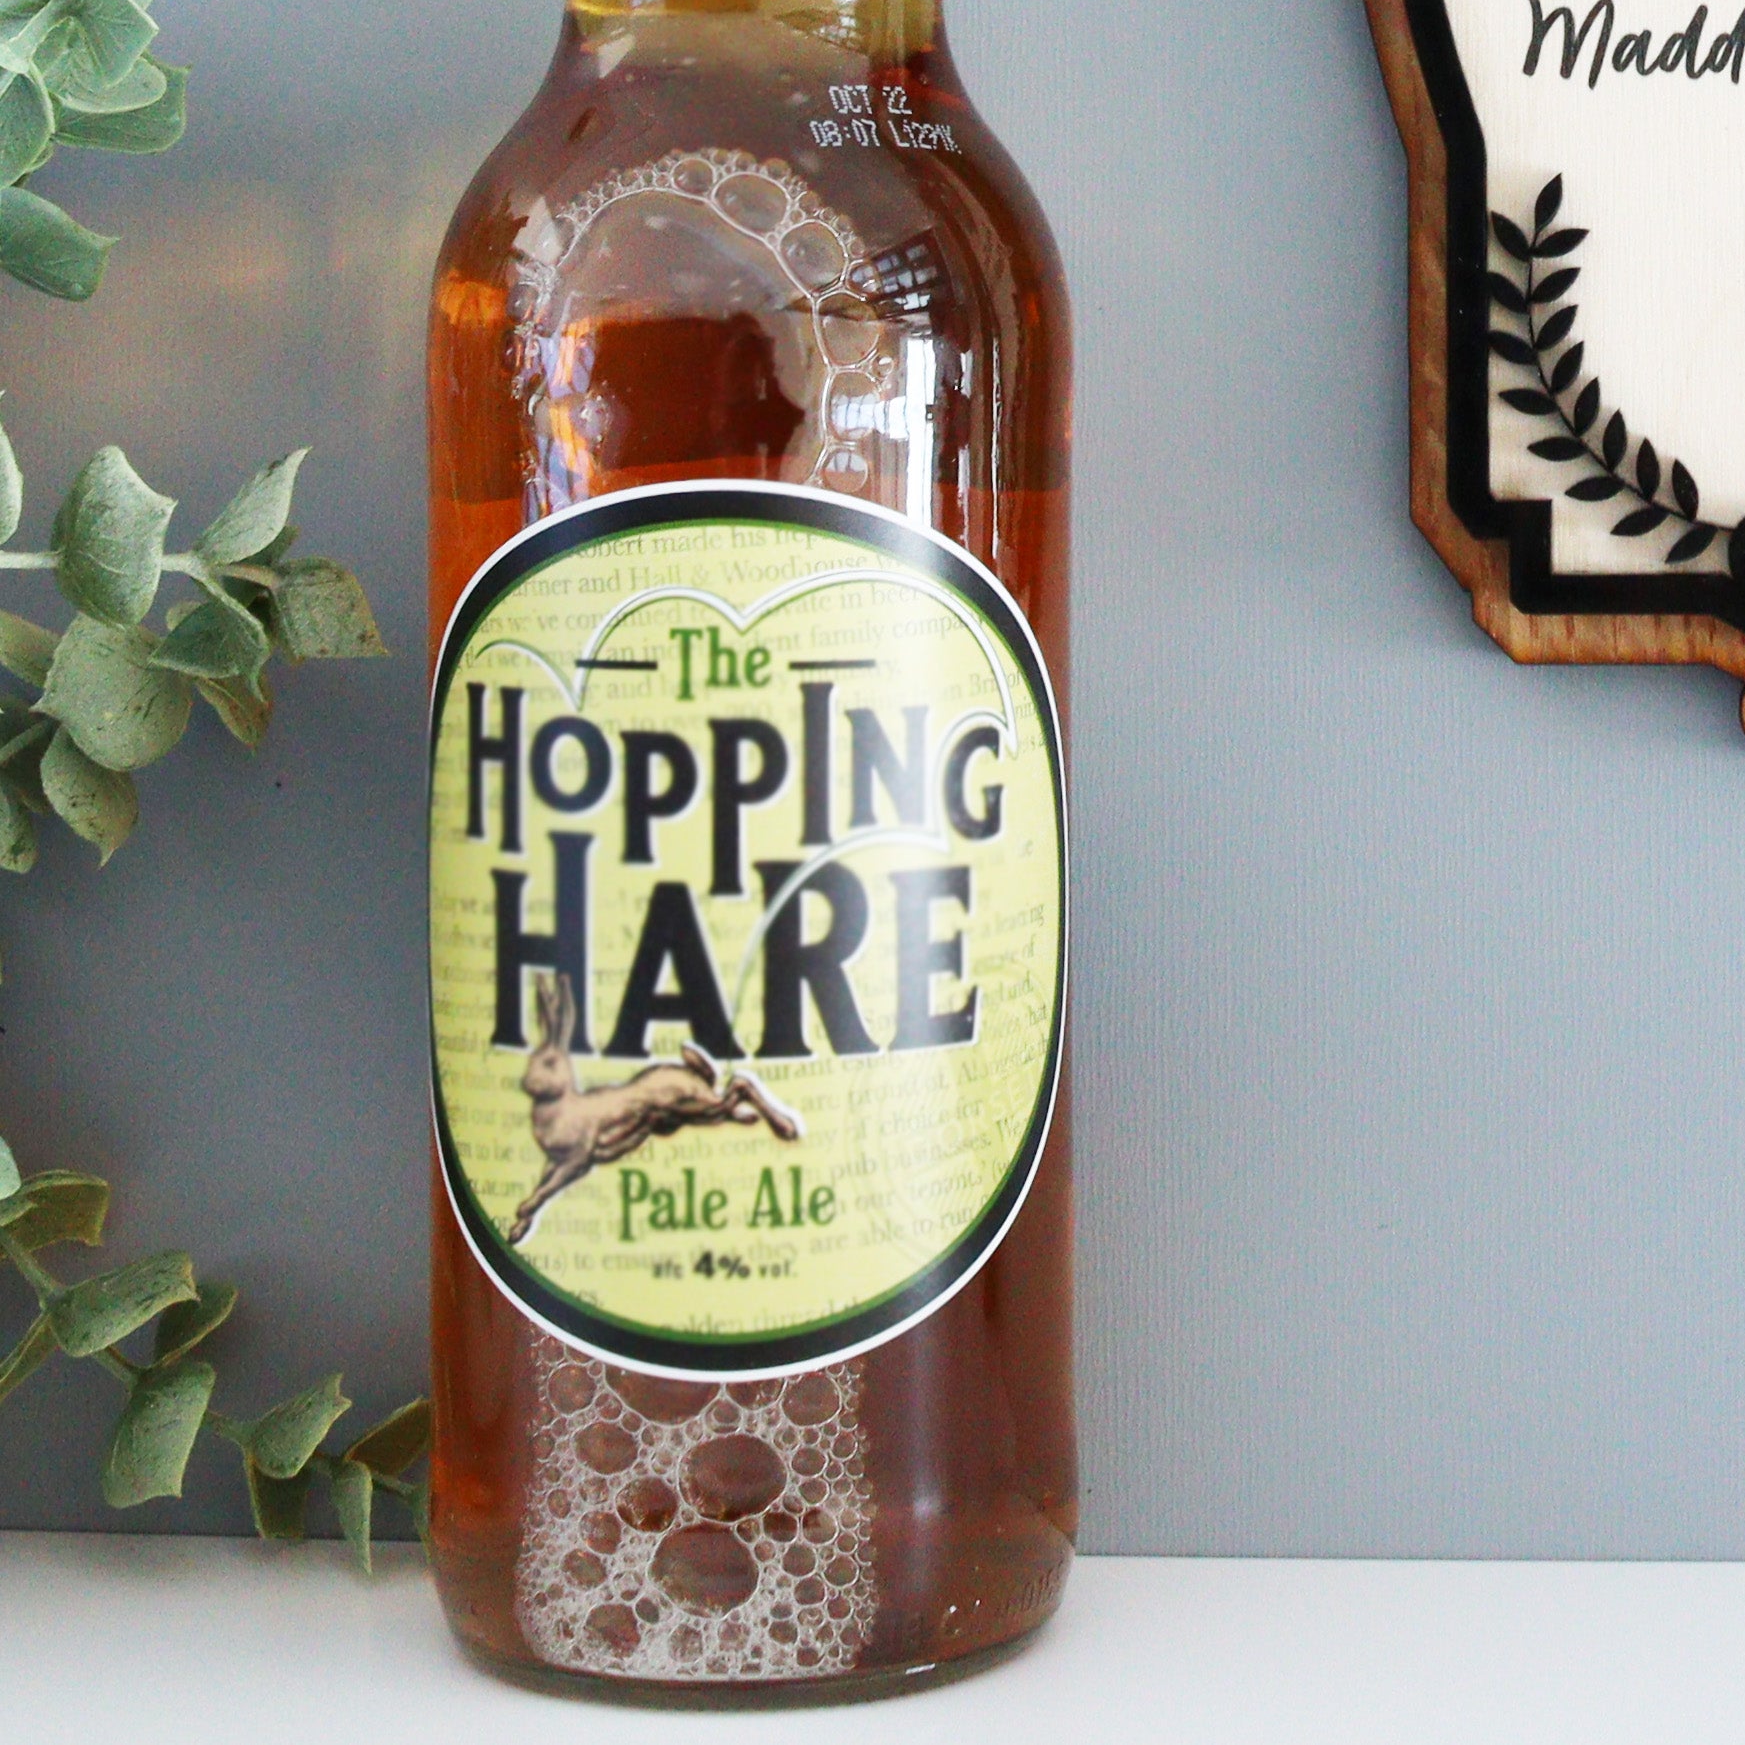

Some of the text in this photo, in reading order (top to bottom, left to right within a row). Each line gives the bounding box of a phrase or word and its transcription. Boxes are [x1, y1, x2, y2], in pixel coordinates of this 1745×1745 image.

[828, 84, 873, 115] OCT
[669, 626, 774, 702] The
[464, 679, 1006, 897] HOPPING
[488, 830, 982, 1062] HARE
[618, 1167, 728, 1242] Pale
[748, 1165, 836, 1230] Ale
[692, 1249, 752, 1280] 4%
